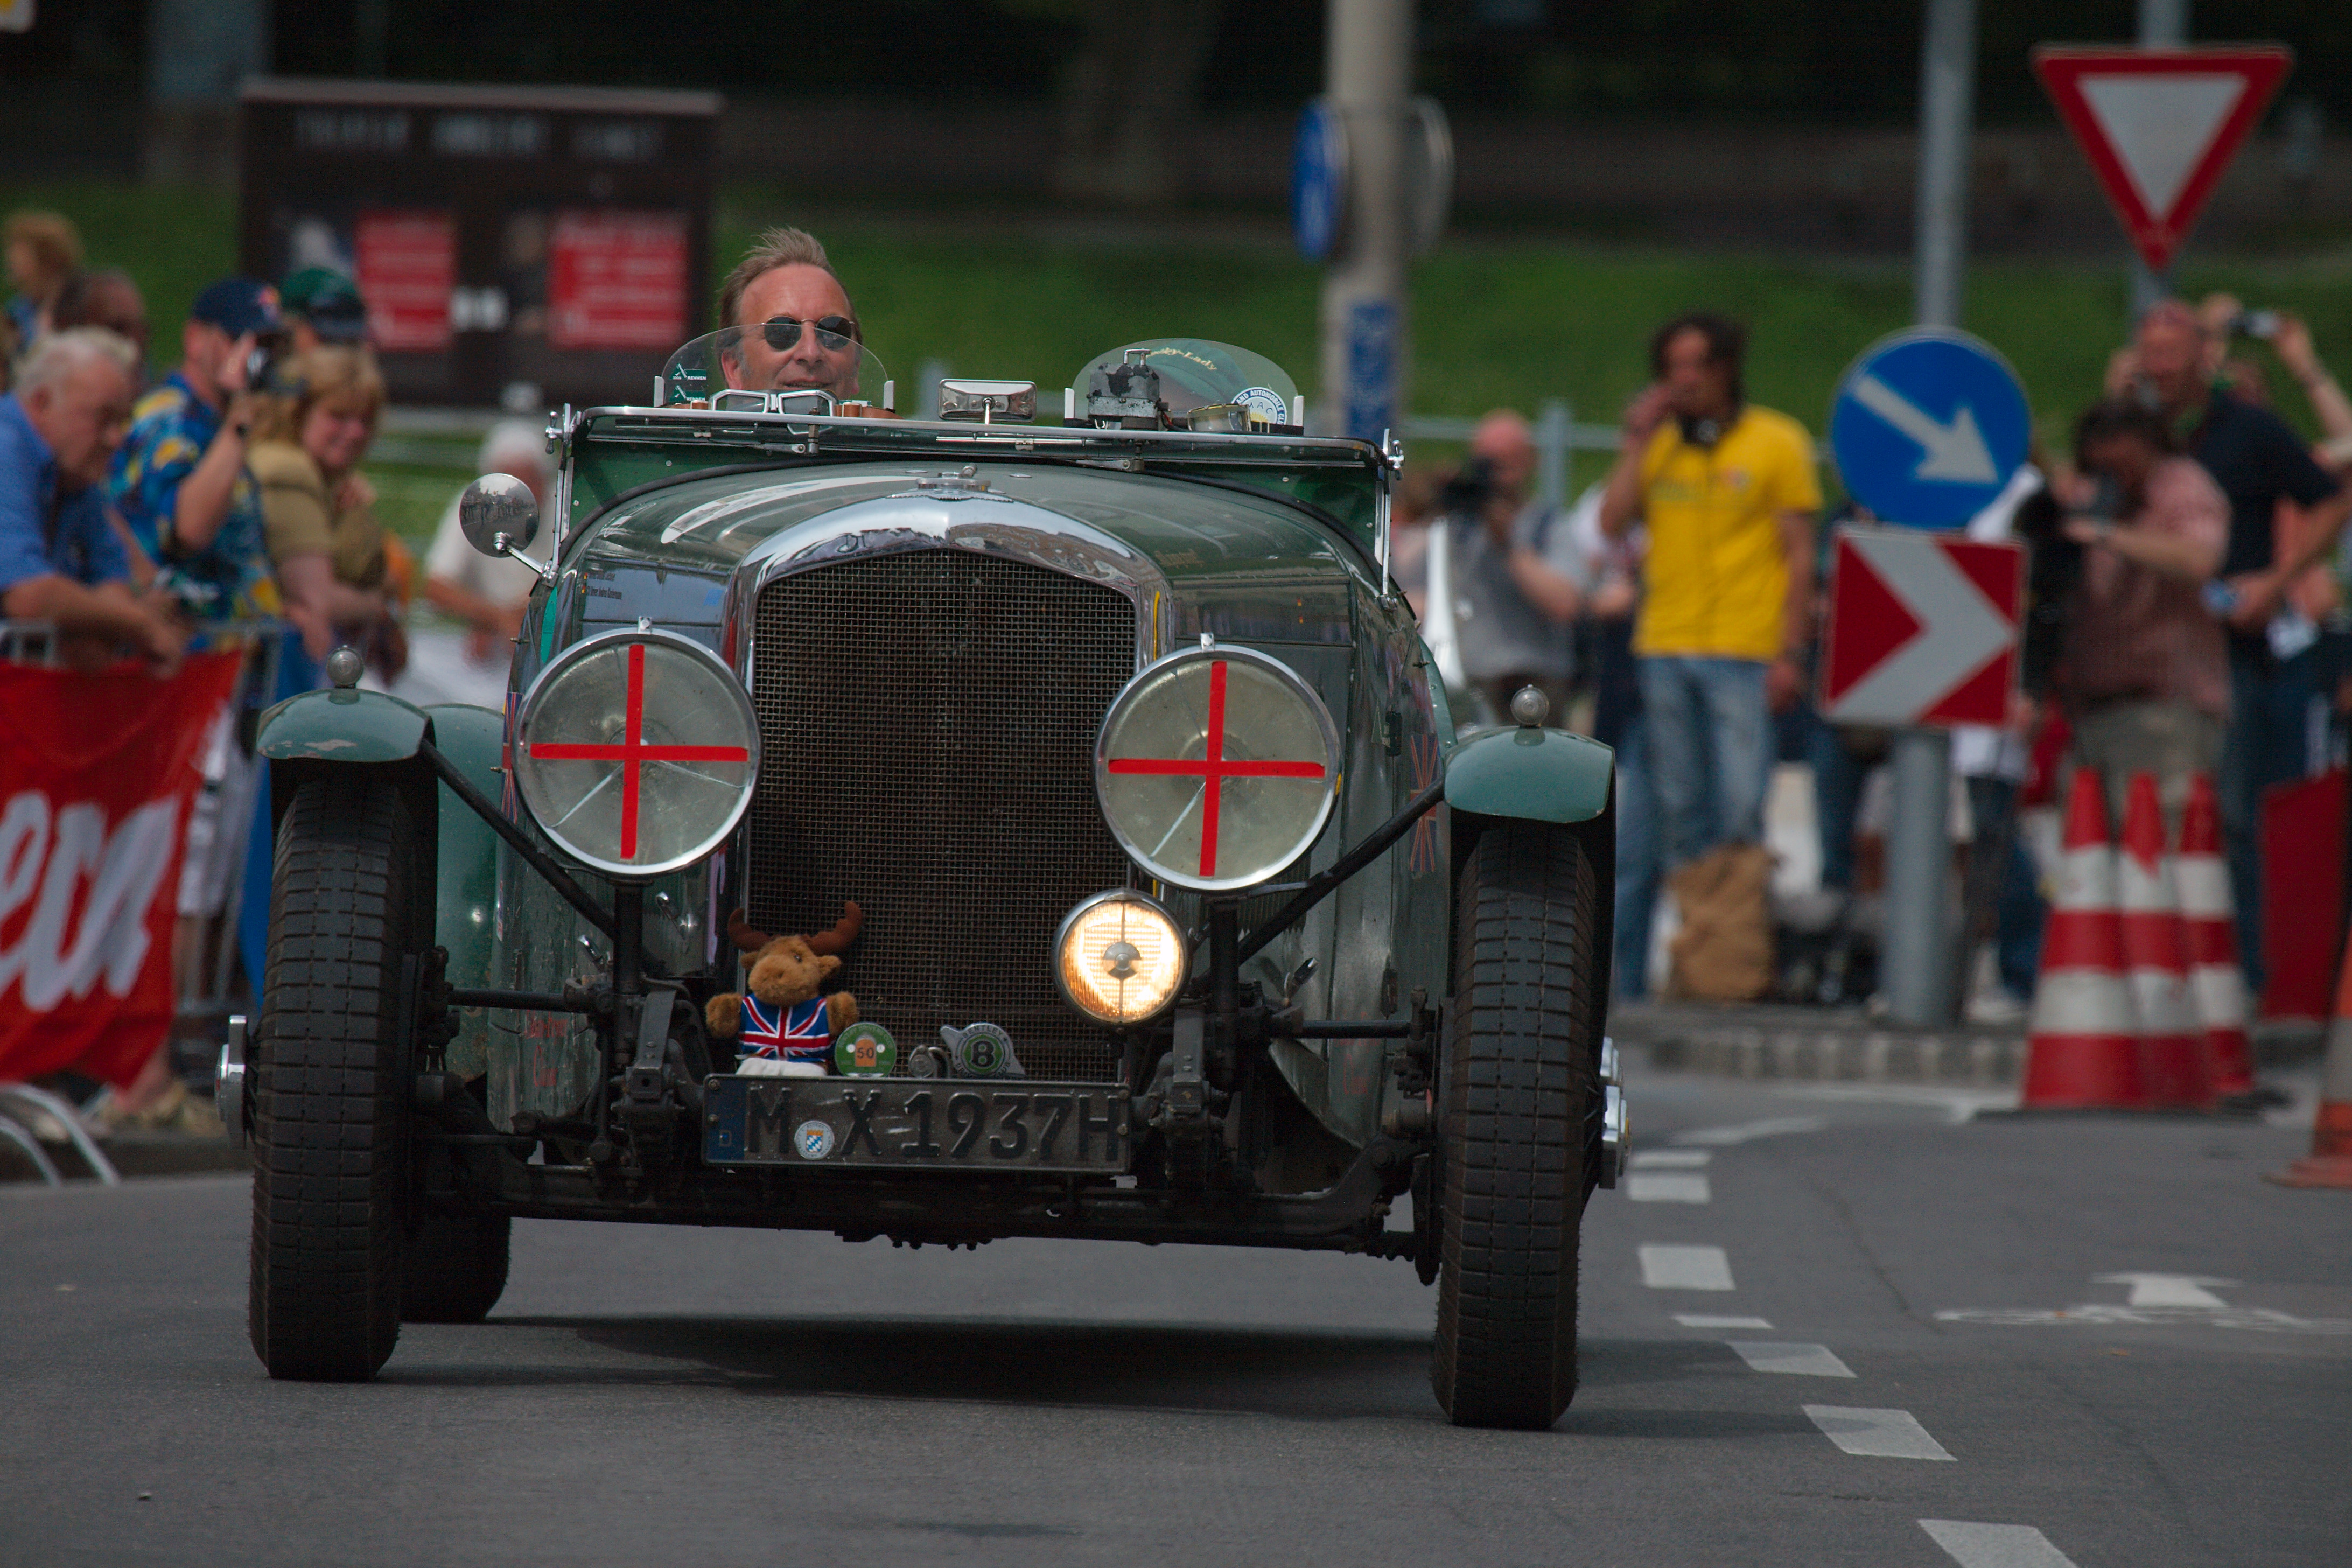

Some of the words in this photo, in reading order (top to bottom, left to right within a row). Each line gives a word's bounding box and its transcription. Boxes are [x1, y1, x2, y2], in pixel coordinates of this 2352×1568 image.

[1250, 390, 1284, 412] AUTOMOBILE
[962, 1025, 1004, 1038] BENTLEY
[857, 1047, 874, 1059] 50
[972, 1040, 995, 1068] B
[748, 1087, 792, 1154] M
[840, 1089, 881, 1156] X
[900, 1090, 1118, 1162] 1937H
